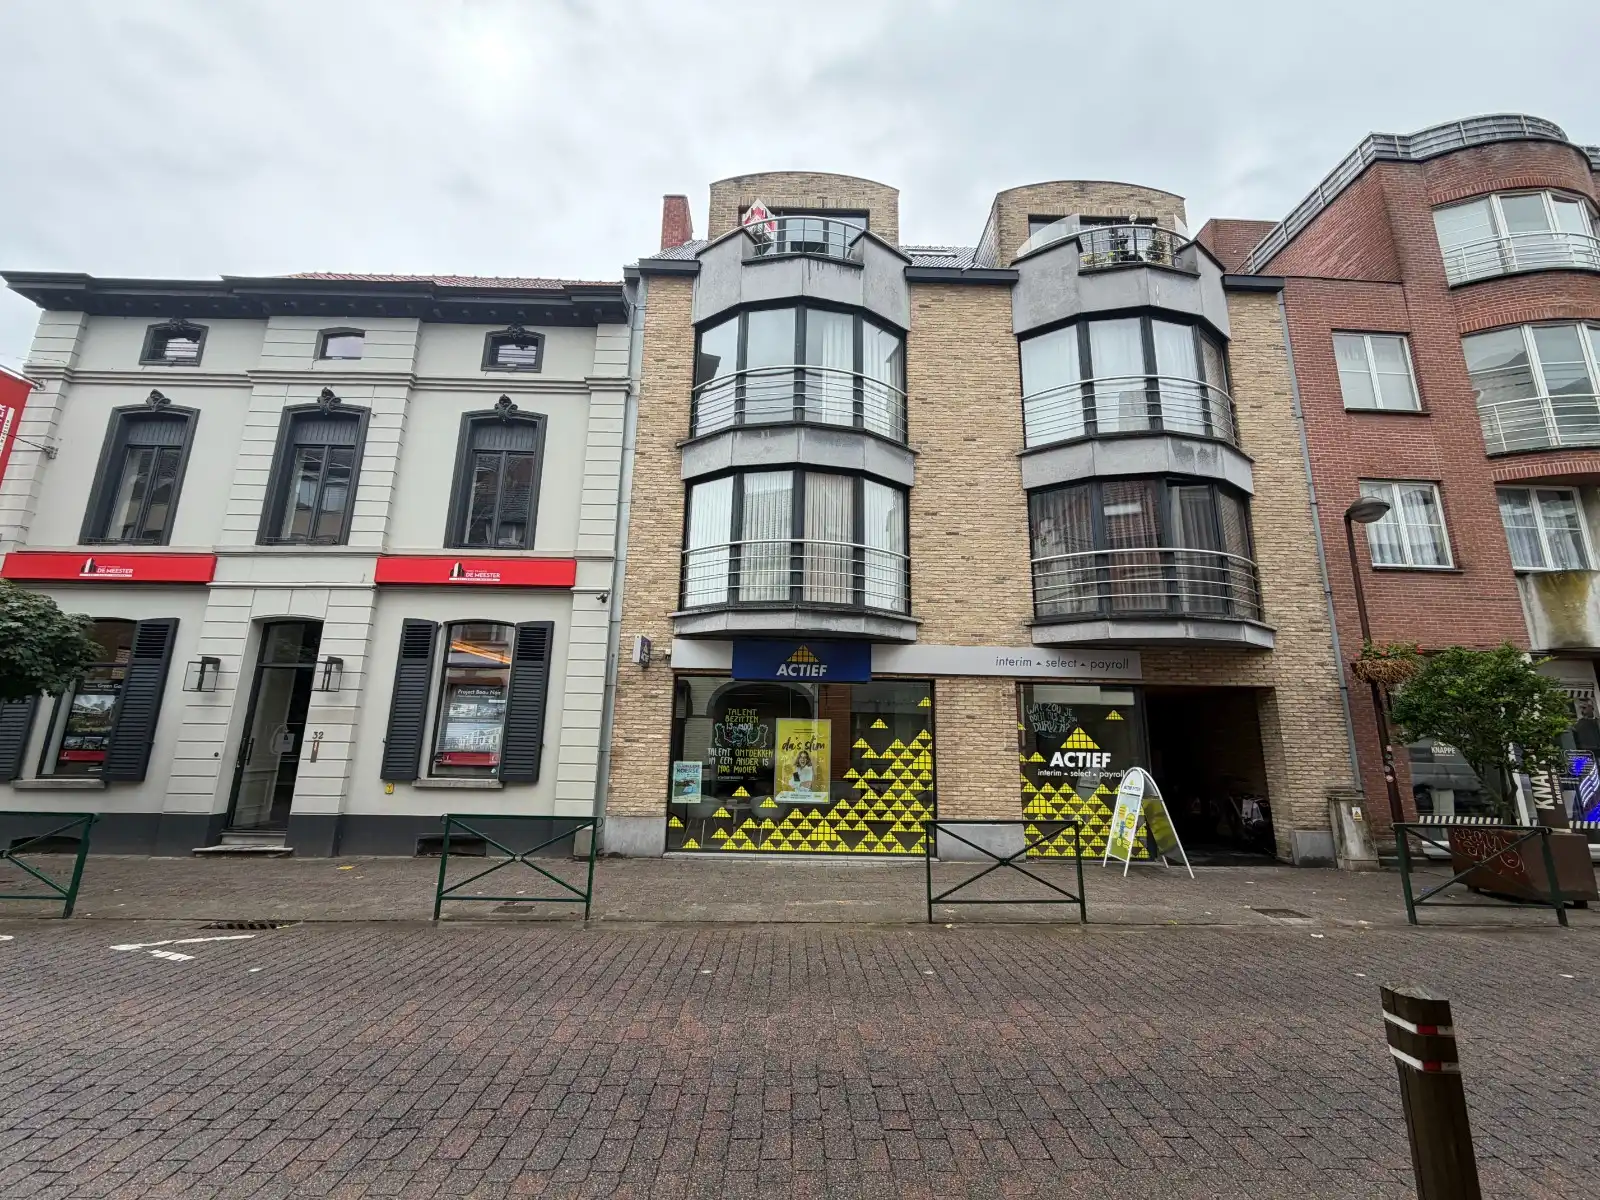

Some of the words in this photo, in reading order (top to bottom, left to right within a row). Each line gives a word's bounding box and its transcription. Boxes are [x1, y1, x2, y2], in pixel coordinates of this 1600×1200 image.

[995, 656, 1032, 667] interim
[1045, 656, 1077, 668] select
[1090, 658, 1129, 672] payroll
[776, 663, 828, 677] ACTIEF
[457, 688, 475, 696] Project
[727, 707, 757, 716] TALENT
[1045, 703, 1062, 714] ZOU
[1064, 707, 1073, 717] JE
[725, 715, 759, 723] BEZITTEN
[312, 731, 324, 740] 32
[707, 747, 732, 757] TALENT
[734, 748, 774, 758] ONTDEKKEN
[1431, 746, 1456, 754] KNAPPE
[708, 757, 716, 765] IN
[719, 756, 733, 765] EEN
[736, 757, 759, 767] ANDER
[762, 758, 769, 766] IS
[1049, 751, 1112, 768] ACTIEF
[717, 764, 730, 774] NOG
[733, 765, 757, 774] MOOIER
[1037, 768, 1062, 776] interim
[1070, 768, 1091, 777] select
[1099, 769, 1125, 779] payroll
